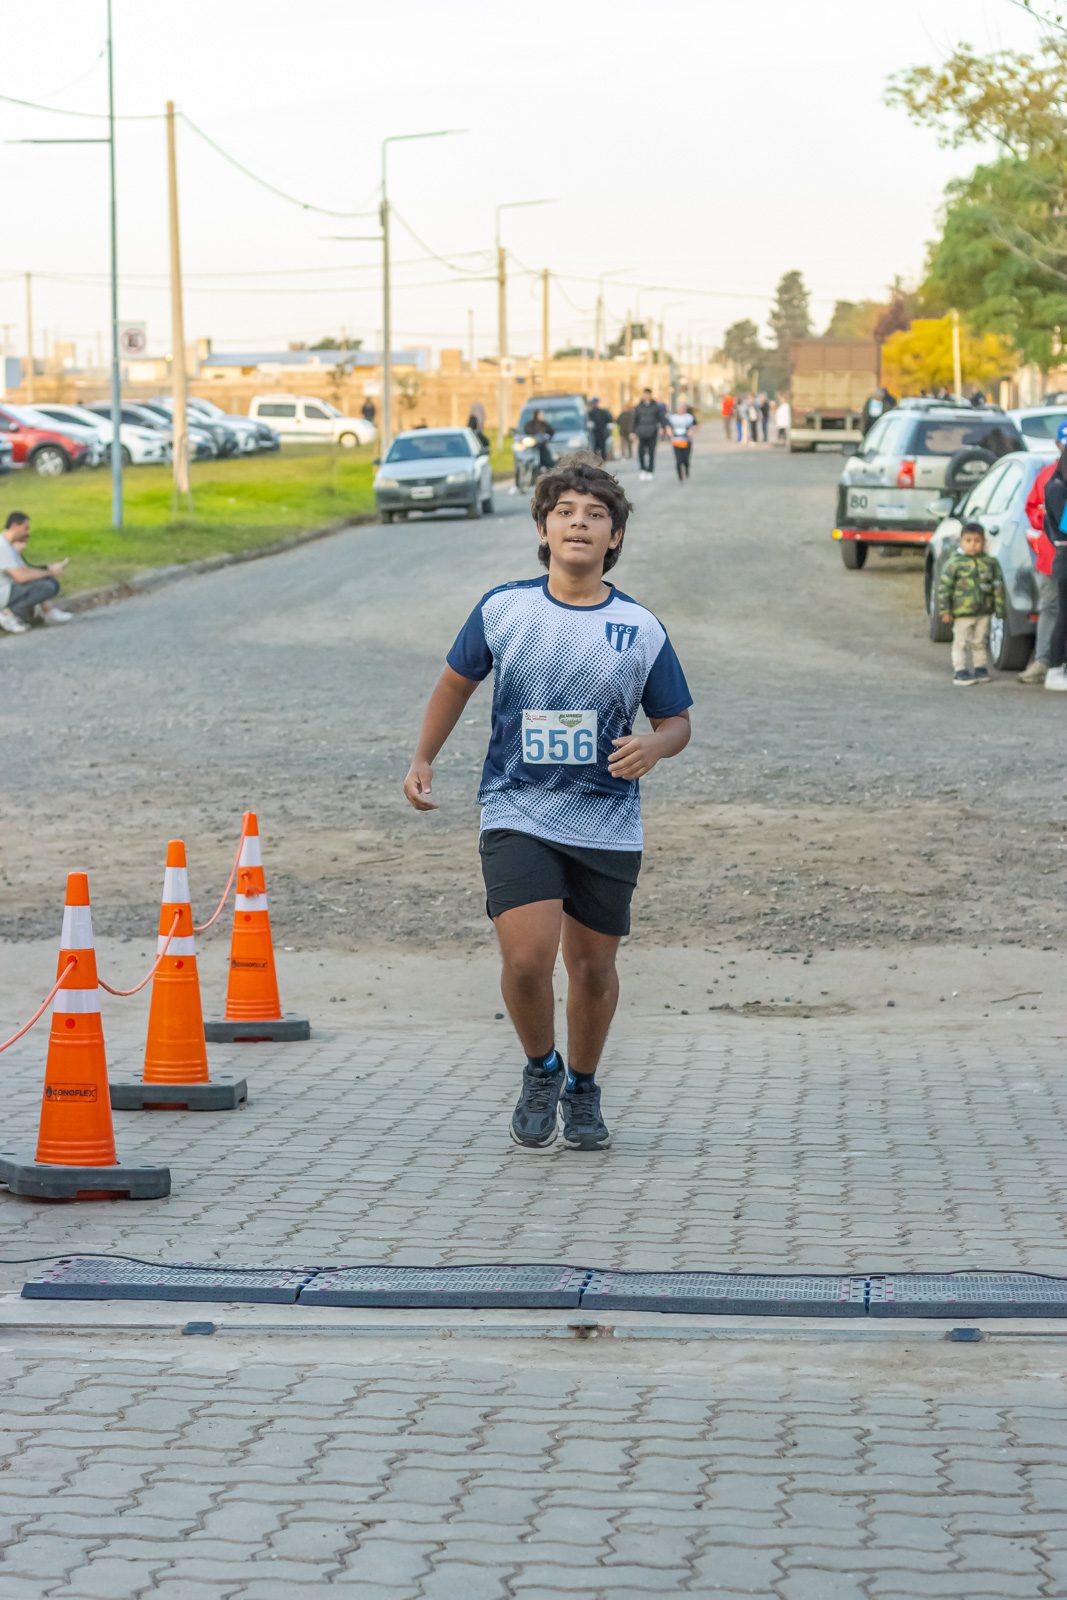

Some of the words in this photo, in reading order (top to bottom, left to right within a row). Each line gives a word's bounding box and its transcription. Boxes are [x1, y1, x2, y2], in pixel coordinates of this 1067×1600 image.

[850, 494, 868, 508] 80
[611, 624, 633, 634] SFC
[525, 728, 594, 762] 556
[52, 1088, 95, 1097] CONOFLEX
